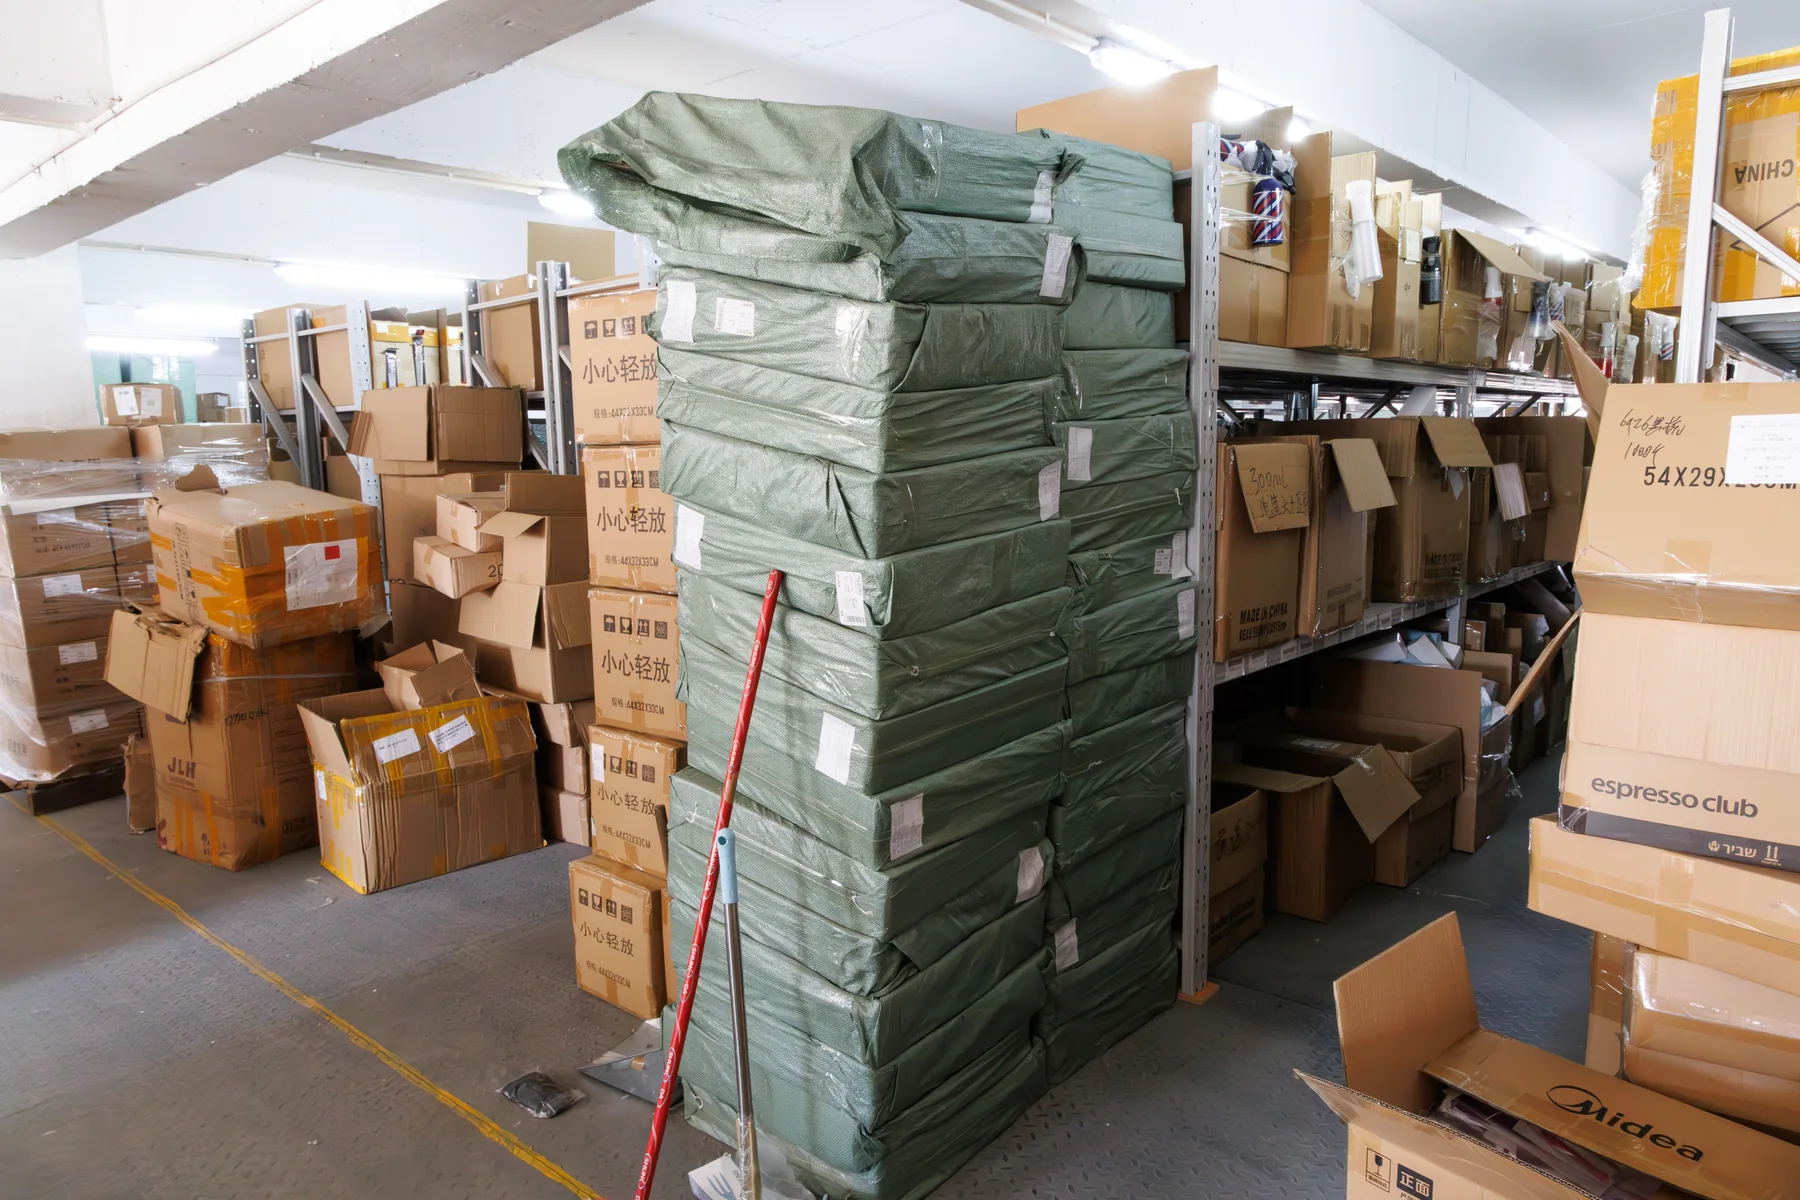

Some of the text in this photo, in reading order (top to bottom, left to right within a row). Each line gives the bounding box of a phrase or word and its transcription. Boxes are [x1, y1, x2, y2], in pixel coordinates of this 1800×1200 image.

[1735, 158, 1794, 185] CHINA
[582, 353, 658, 385] 小心轻放
[596, 506, 667, 534] 小心轻放
[1240, 608, 1261, 625] MADE
[1269, 602, 1288, 619] CHINA
[601, 649, 671, 684] 小心轻放
[597, 784, 656, 816] 小心轻放
[1591, 777, 1759, 819] espresso club
[1723, 843, 1758, 858] שביר
[580, 920, 635, 957] 小心轻放
[665, 1051, 675, 1075] SHUN
[1546, 1084, 1704, 1163] Midea
[1399, 1171, 1431, 1198] 正面
